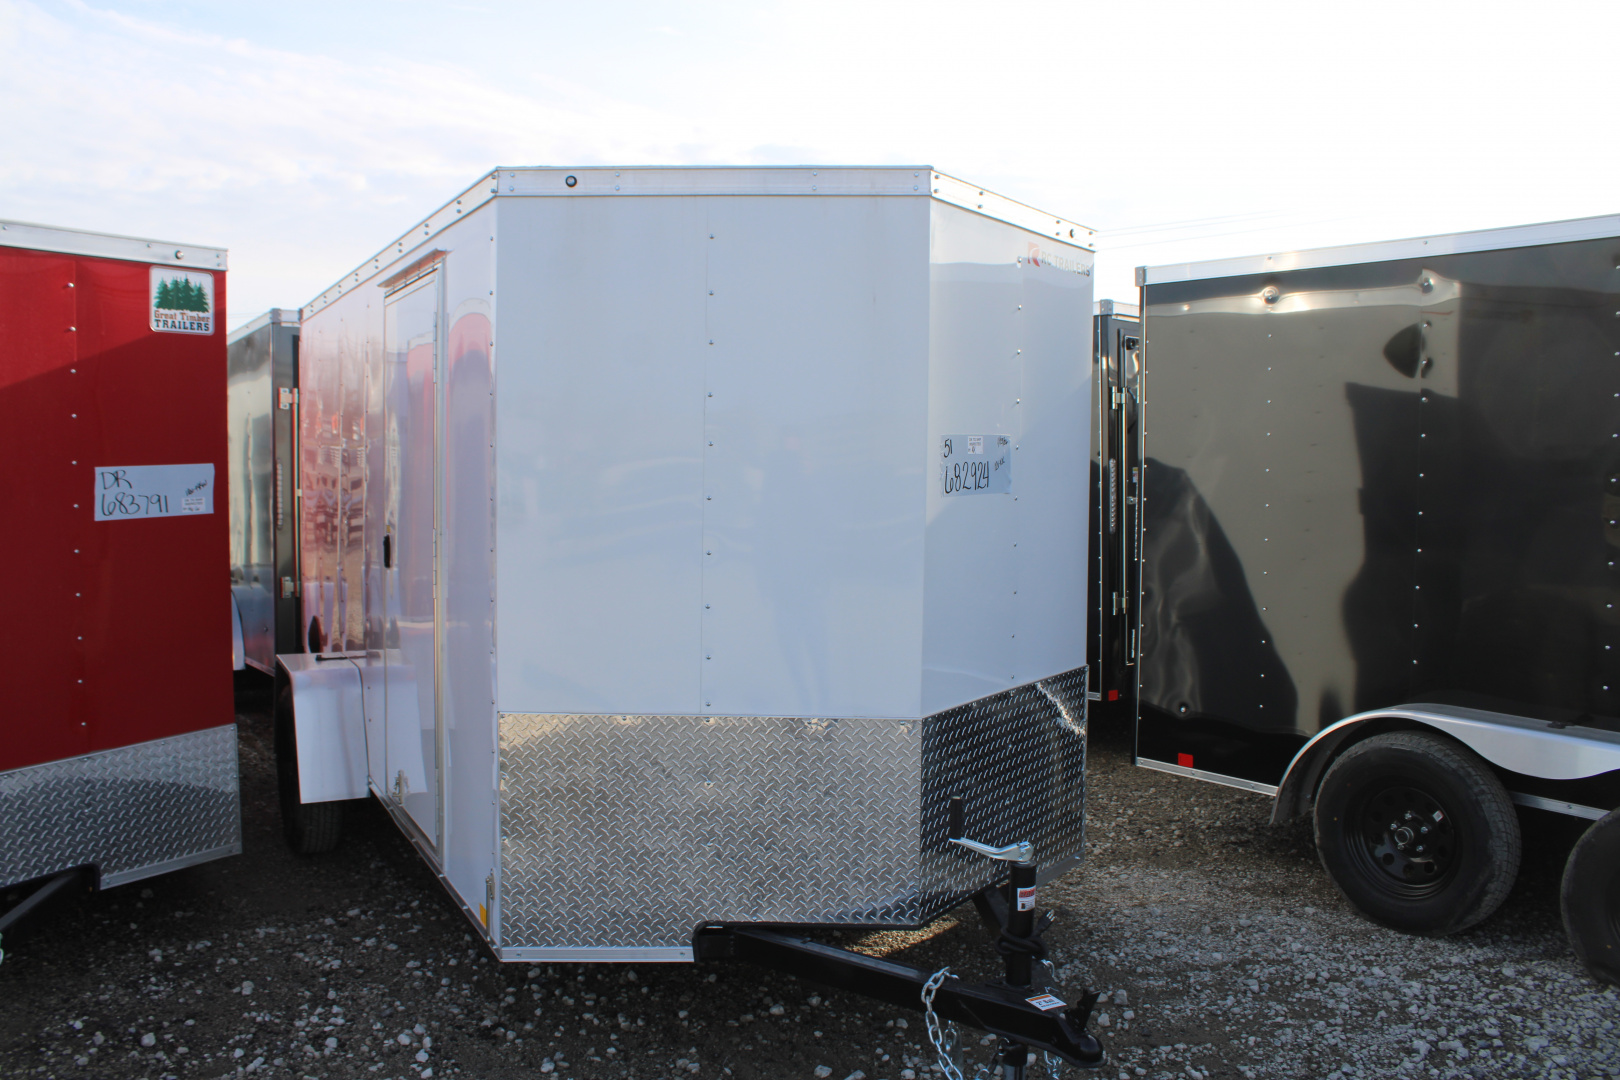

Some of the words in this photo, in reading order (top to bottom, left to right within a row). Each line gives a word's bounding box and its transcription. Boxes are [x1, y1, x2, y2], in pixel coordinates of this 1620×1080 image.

[1041, 250, 1053, 266] RC
[1054, 253, 1091, 277] TRAILERS
[154, 309, 178, 320] Great
[180, 312, 211, 322] Timber
[154, 318, 210, 331] TRAILERS
[101, 469, 132, 490] DR
[944, 460, 989, 494] 682924
[101, 492, 169, 516] 683791
